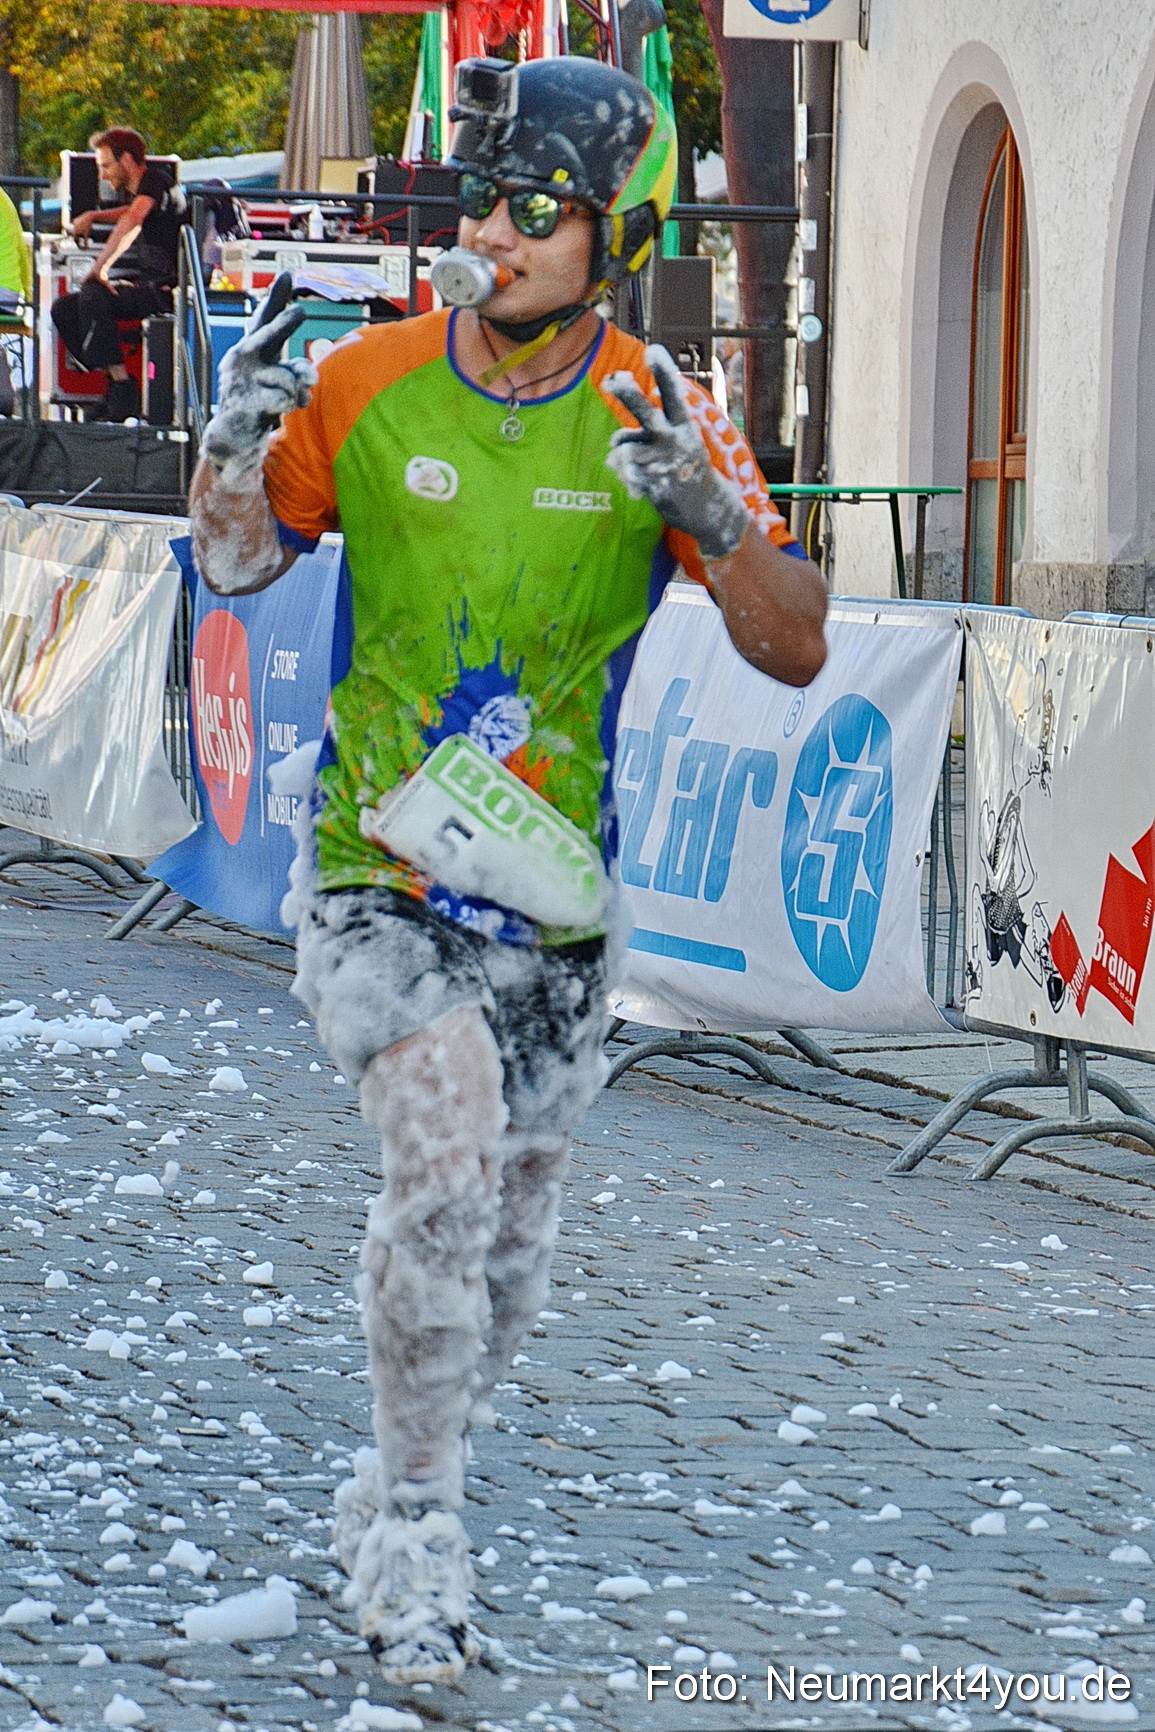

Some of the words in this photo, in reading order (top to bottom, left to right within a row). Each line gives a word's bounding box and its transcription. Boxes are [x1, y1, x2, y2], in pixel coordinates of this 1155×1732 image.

[536, 488, 612, 511] BOCK
[271, 650, 299, 681] STORE
[268, 721, 299, 752] ONLINE
[267, 794, 299, 826] MOBILE
[1093, 925, 1137, 997] Braun
